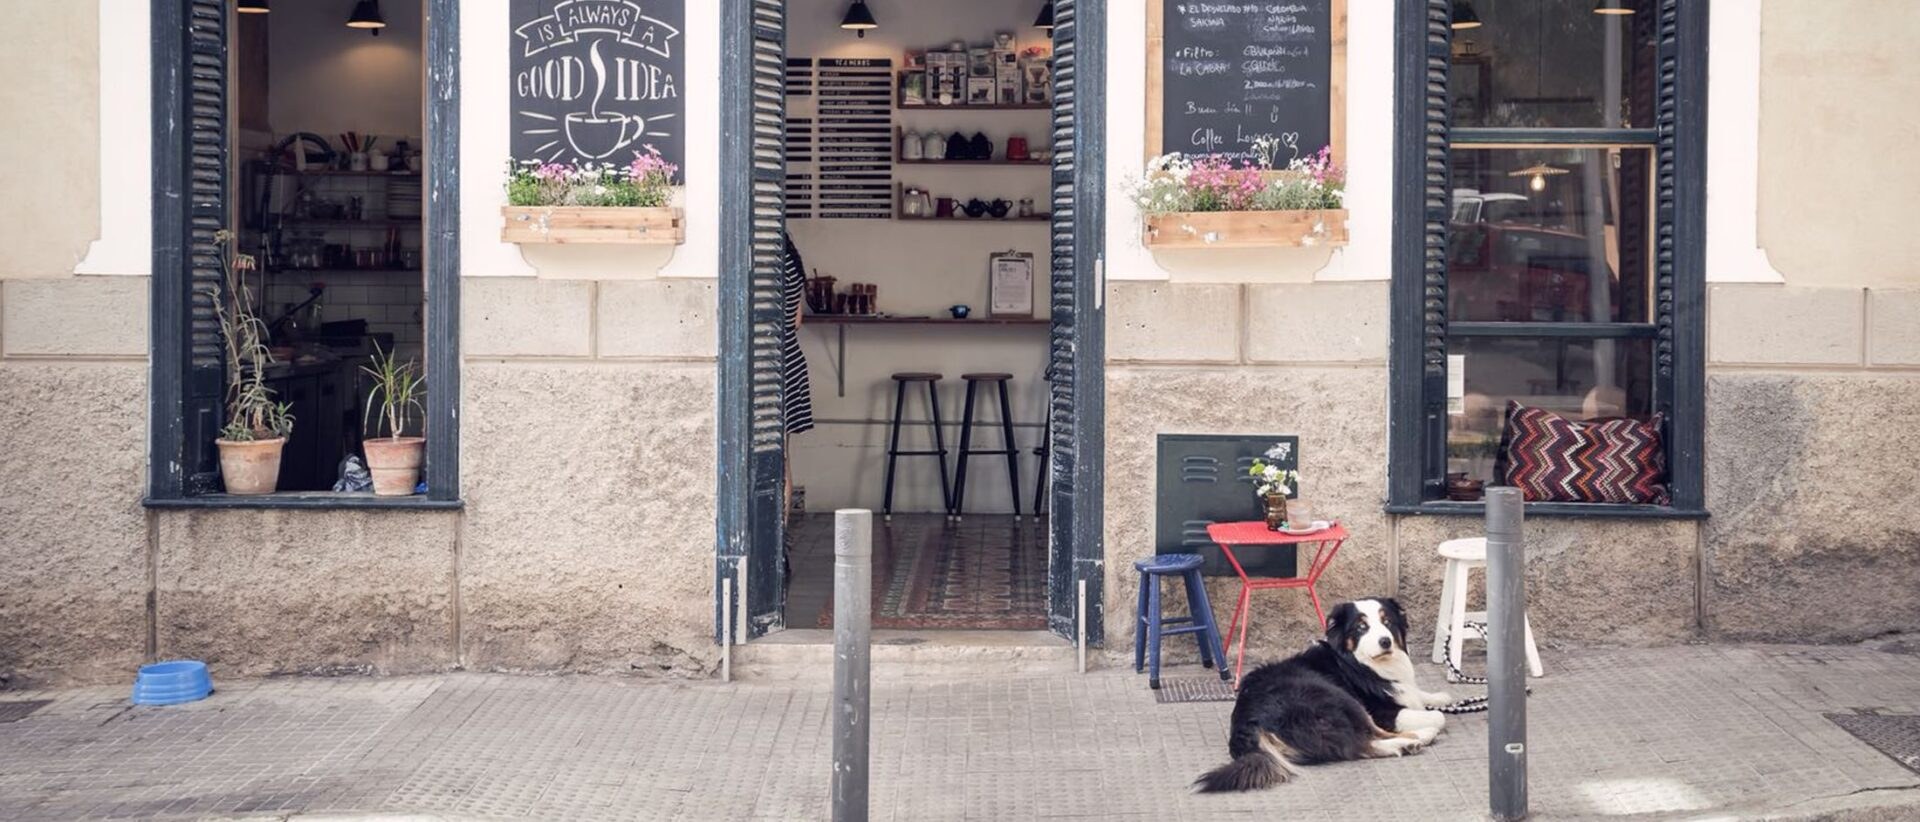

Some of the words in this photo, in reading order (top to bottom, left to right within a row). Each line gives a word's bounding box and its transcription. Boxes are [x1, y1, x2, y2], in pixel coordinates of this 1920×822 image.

[538, 24, 555, 43] IS
[568, 5, 630, 27] ALWAYS
[642, 26, 654, 43] A
[517, 56, 585, 101] GOOD
[614, 57, 678, 101] IDEA
[1191, 127, 1223, 151] Coffee
